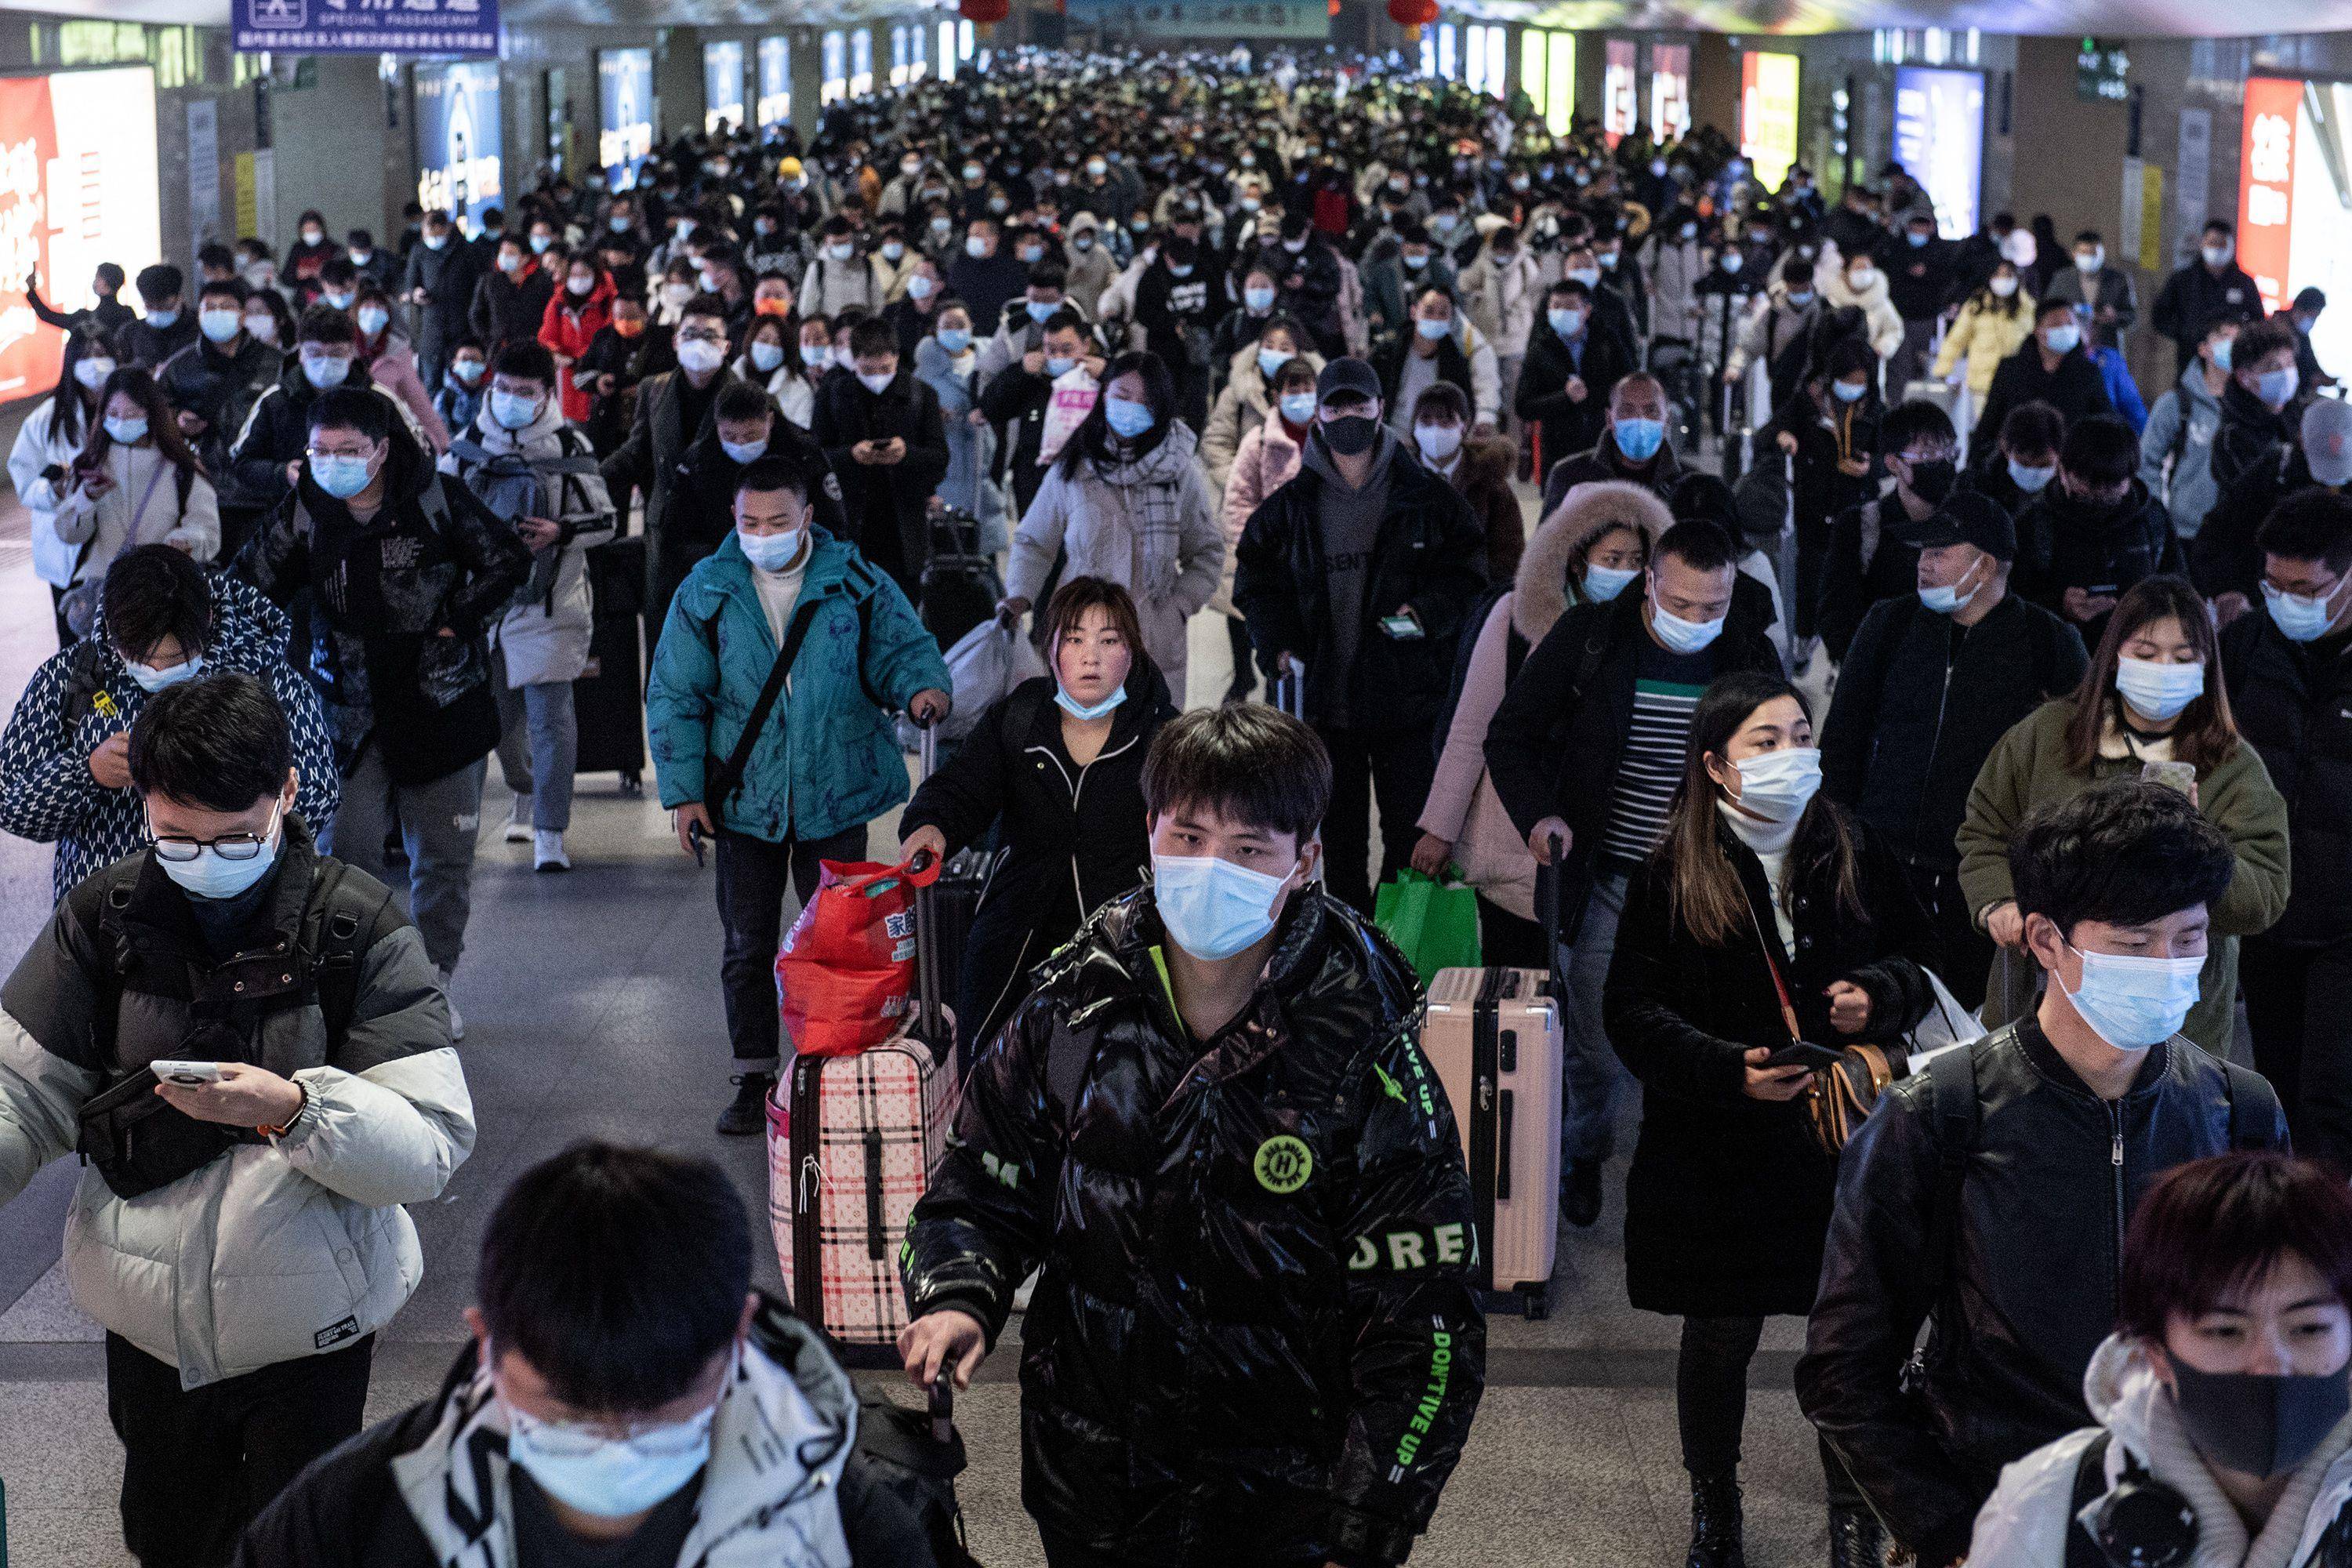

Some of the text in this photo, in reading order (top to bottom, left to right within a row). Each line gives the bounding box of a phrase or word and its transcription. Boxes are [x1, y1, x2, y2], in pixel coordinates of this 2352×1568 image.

[1418, 1083, 1434, 1116] UP
[1276, 1154, 1292, 1174] H
[1396, 1433, 1421, 1466] UP
